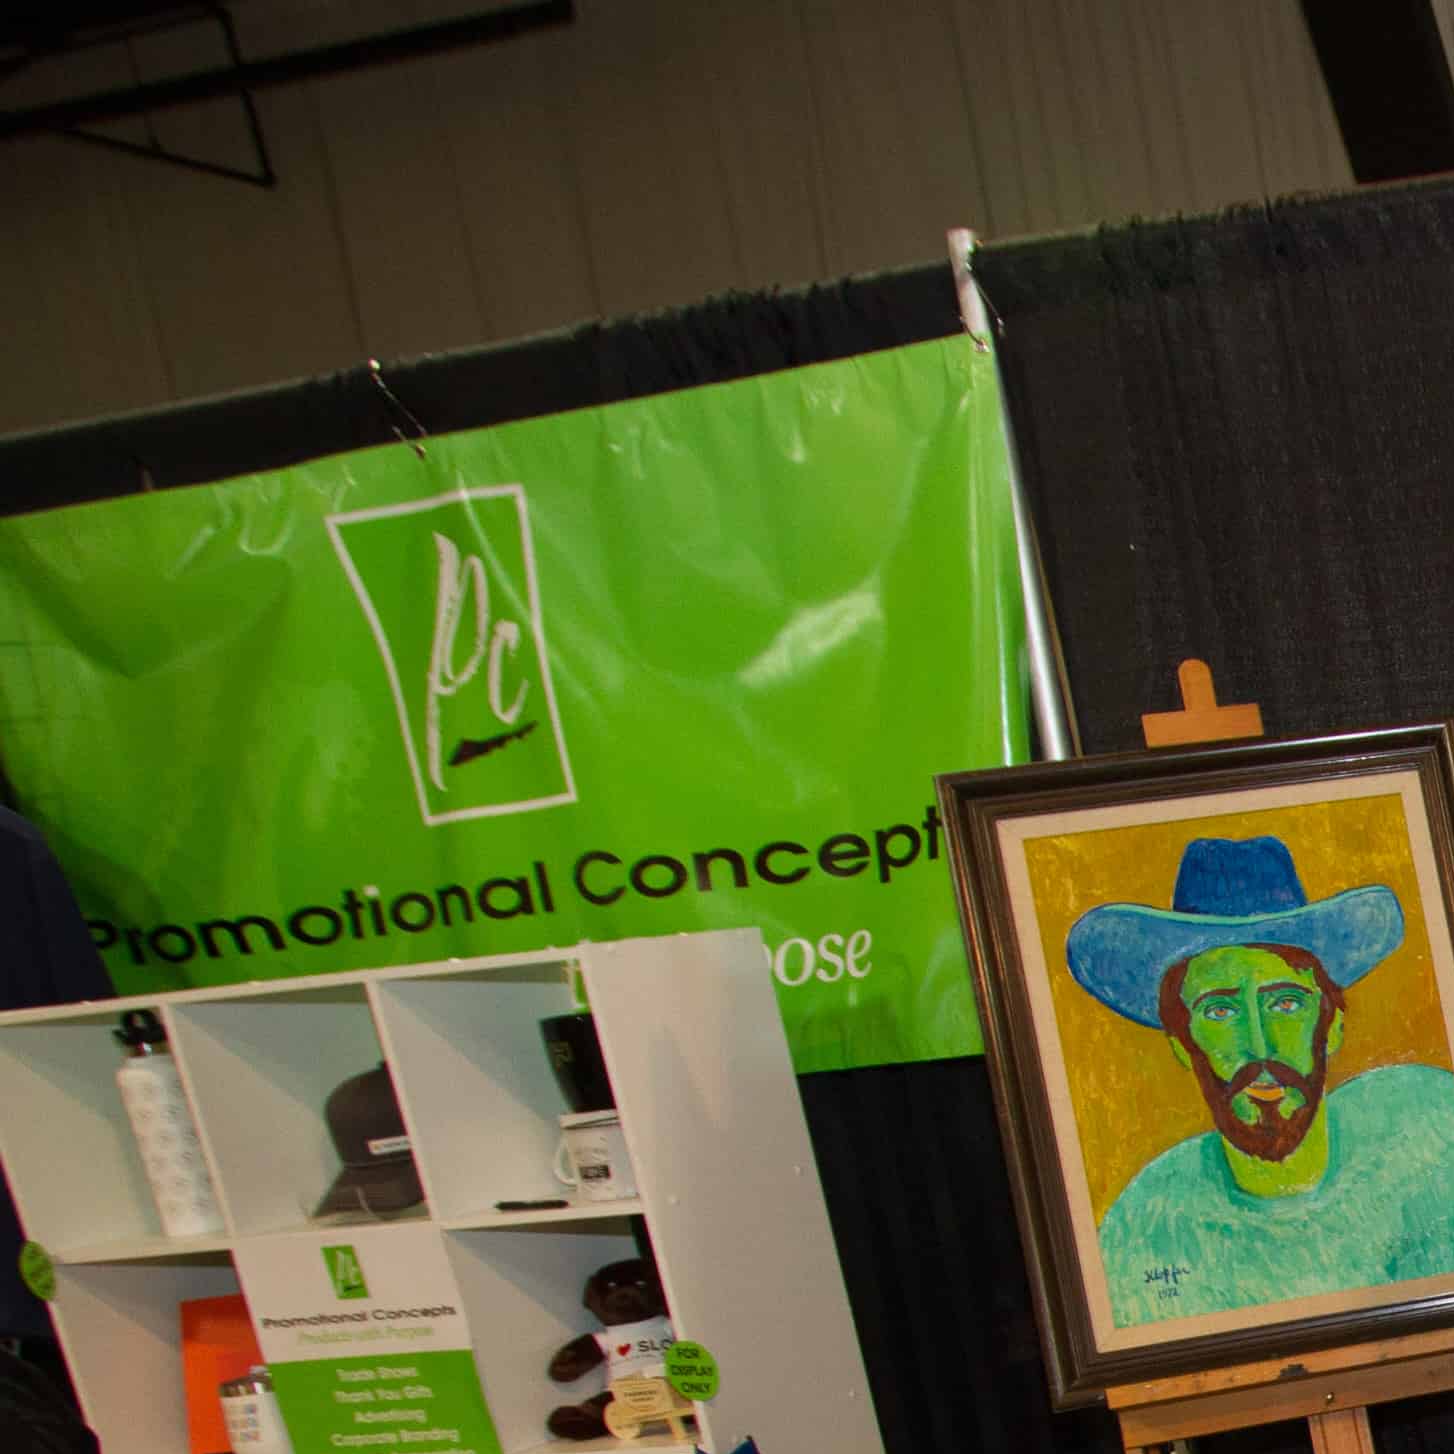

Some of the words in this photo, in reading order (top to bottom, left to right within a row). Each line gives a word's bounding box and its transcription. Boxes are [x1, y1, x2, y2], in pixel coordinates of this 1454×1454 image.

[90, 860, 556, 966] Promotional
[573, 804, 942, 906] Concept
[762, 928, 873, 988] ose
[262, 1310, 367, 1330] Promotional
[372, 1304, 457, 1320] Concepts
